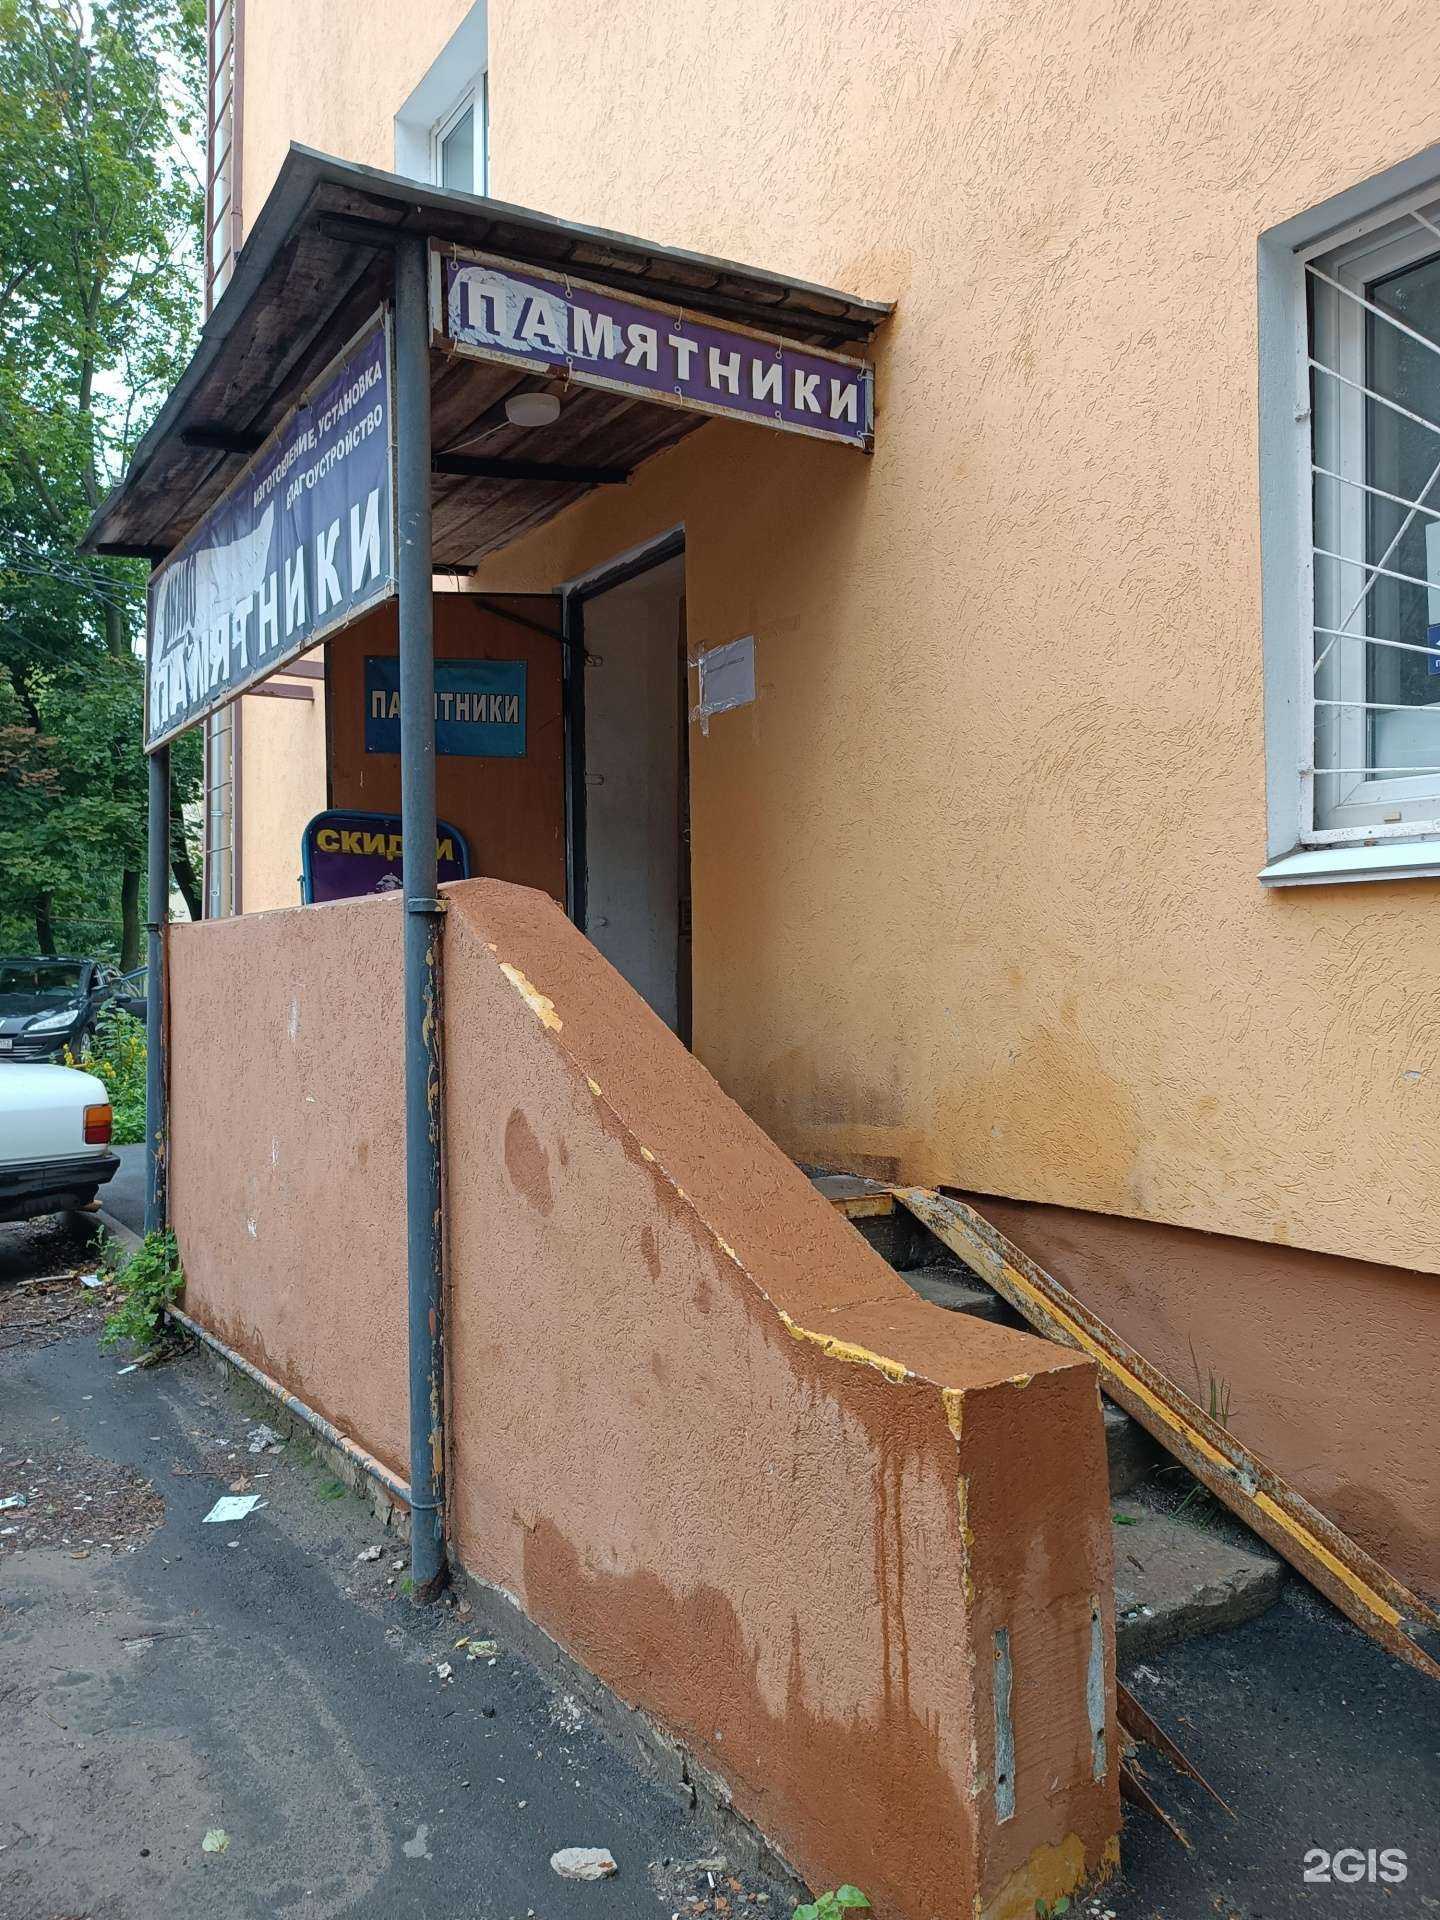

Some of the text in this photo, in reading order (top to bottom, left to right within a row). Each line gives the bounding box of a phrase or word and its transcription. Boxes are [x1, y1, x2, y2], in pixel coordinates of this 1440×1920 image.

[468, 281, 858, 424] ПАМЯТНИКИ
[254, 360, 383, 508] ИЗГОТОВЛЕНИЕ, УСТАНОВКА
[286, 404, 383, 511] БЛАГОУСТРОЙСТВО
[150, 487, 381, 735] ПАМЯТНИКИ
[371, 690, 519, 723] ПАТНИКИ
[316, 829, 453, 861] СКИДИ
